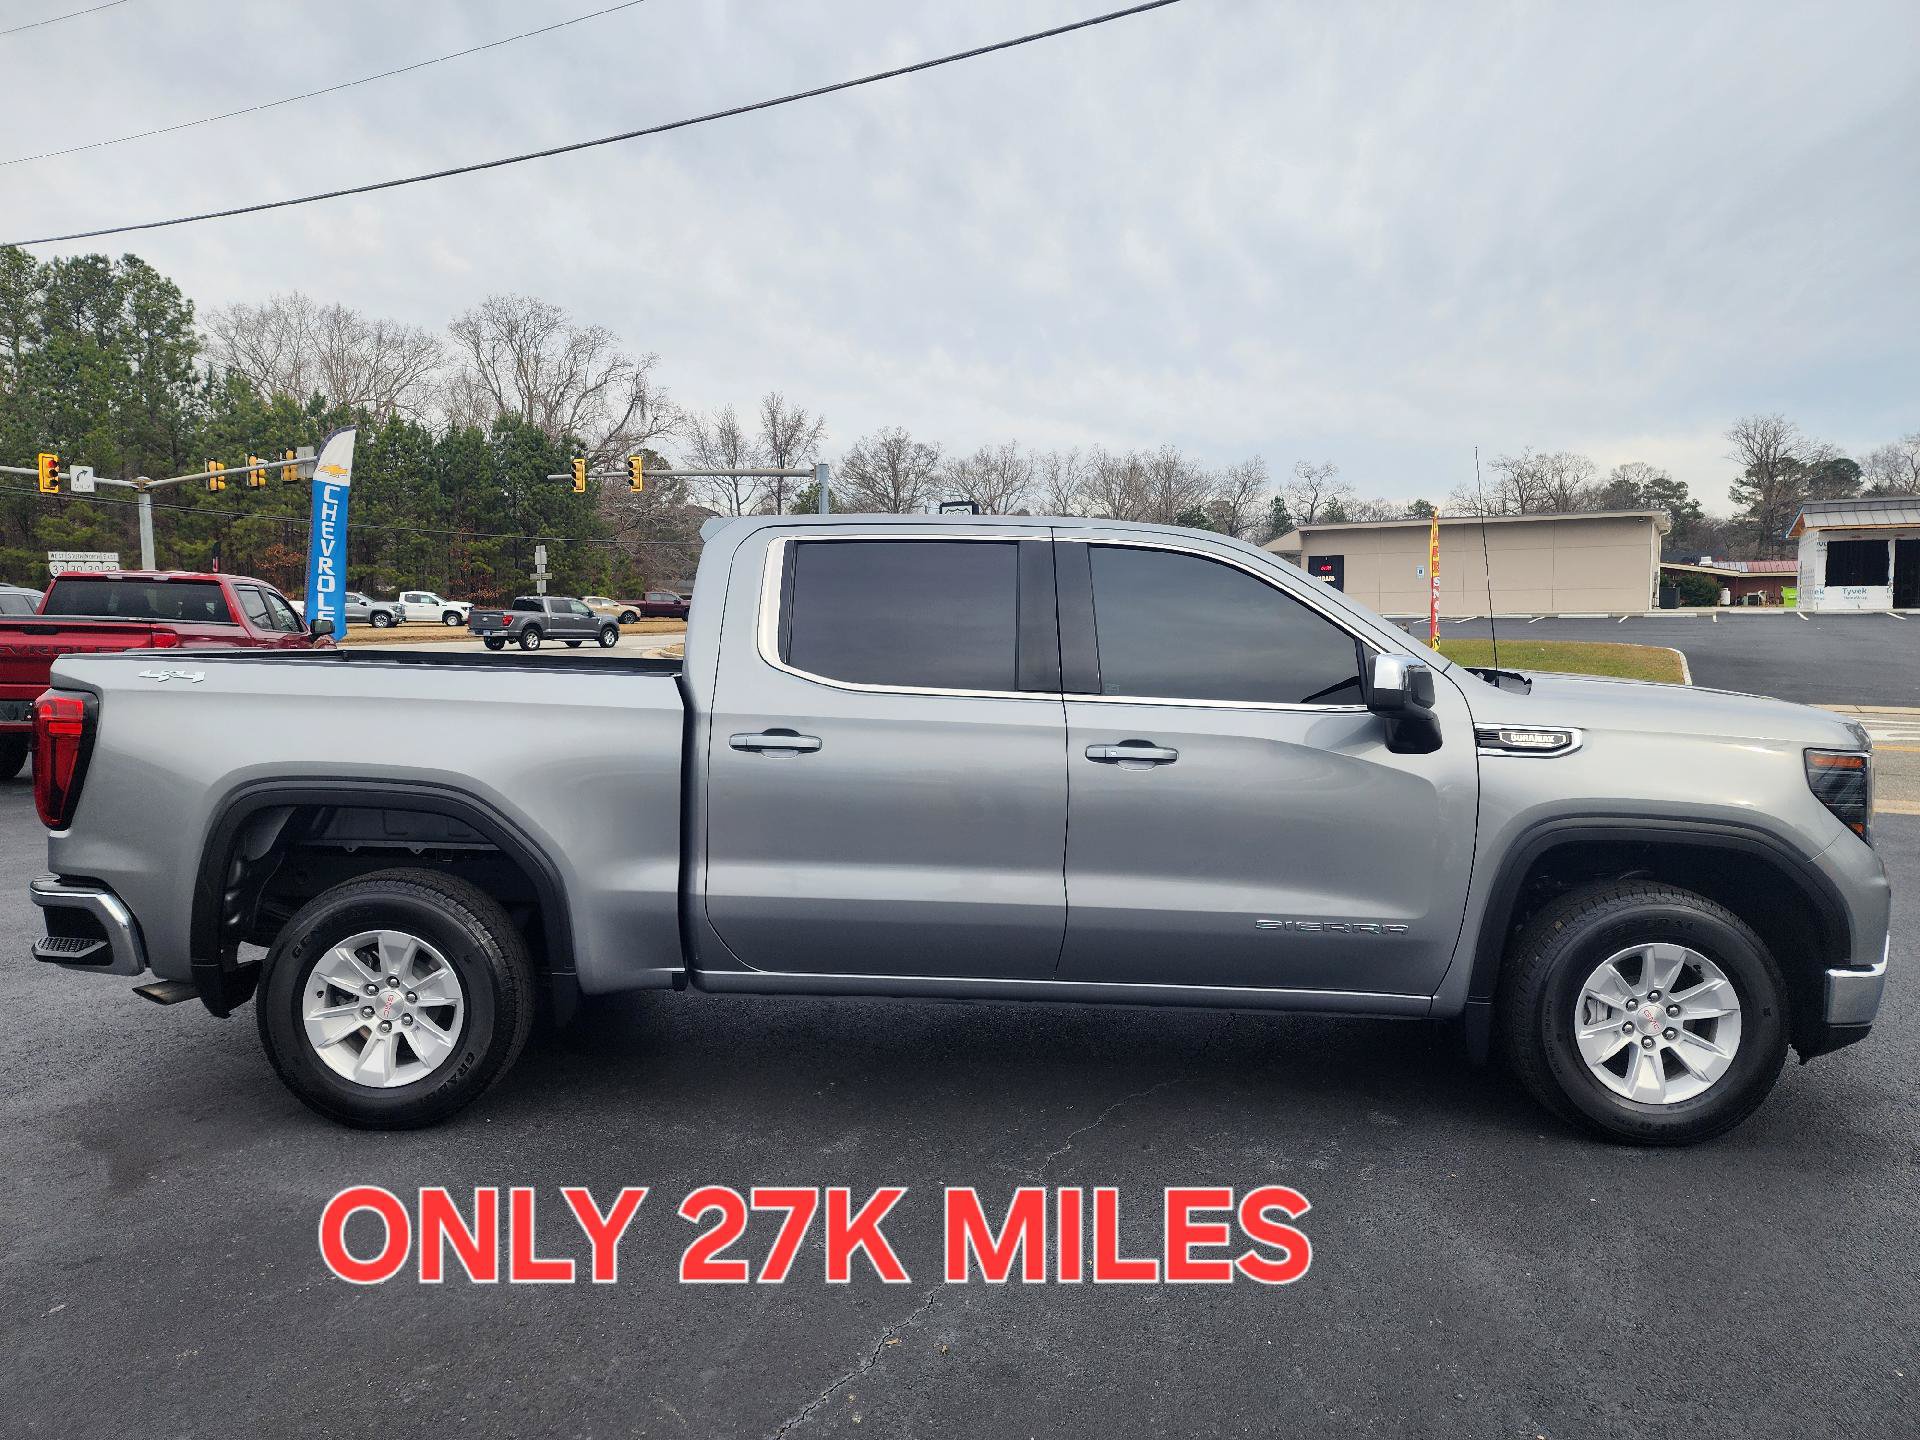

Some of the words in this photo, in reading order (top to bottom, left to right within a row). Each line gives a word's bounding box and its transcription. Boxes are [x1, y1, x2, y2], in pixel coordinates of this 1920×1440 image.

[316, 485, 340, 622] CHEVROLE
[1255, 919, 1409, 935] SIERRA
[383, 994, 395, 1018] GMC
[1643, 1009, 1660, 1031] GMC
